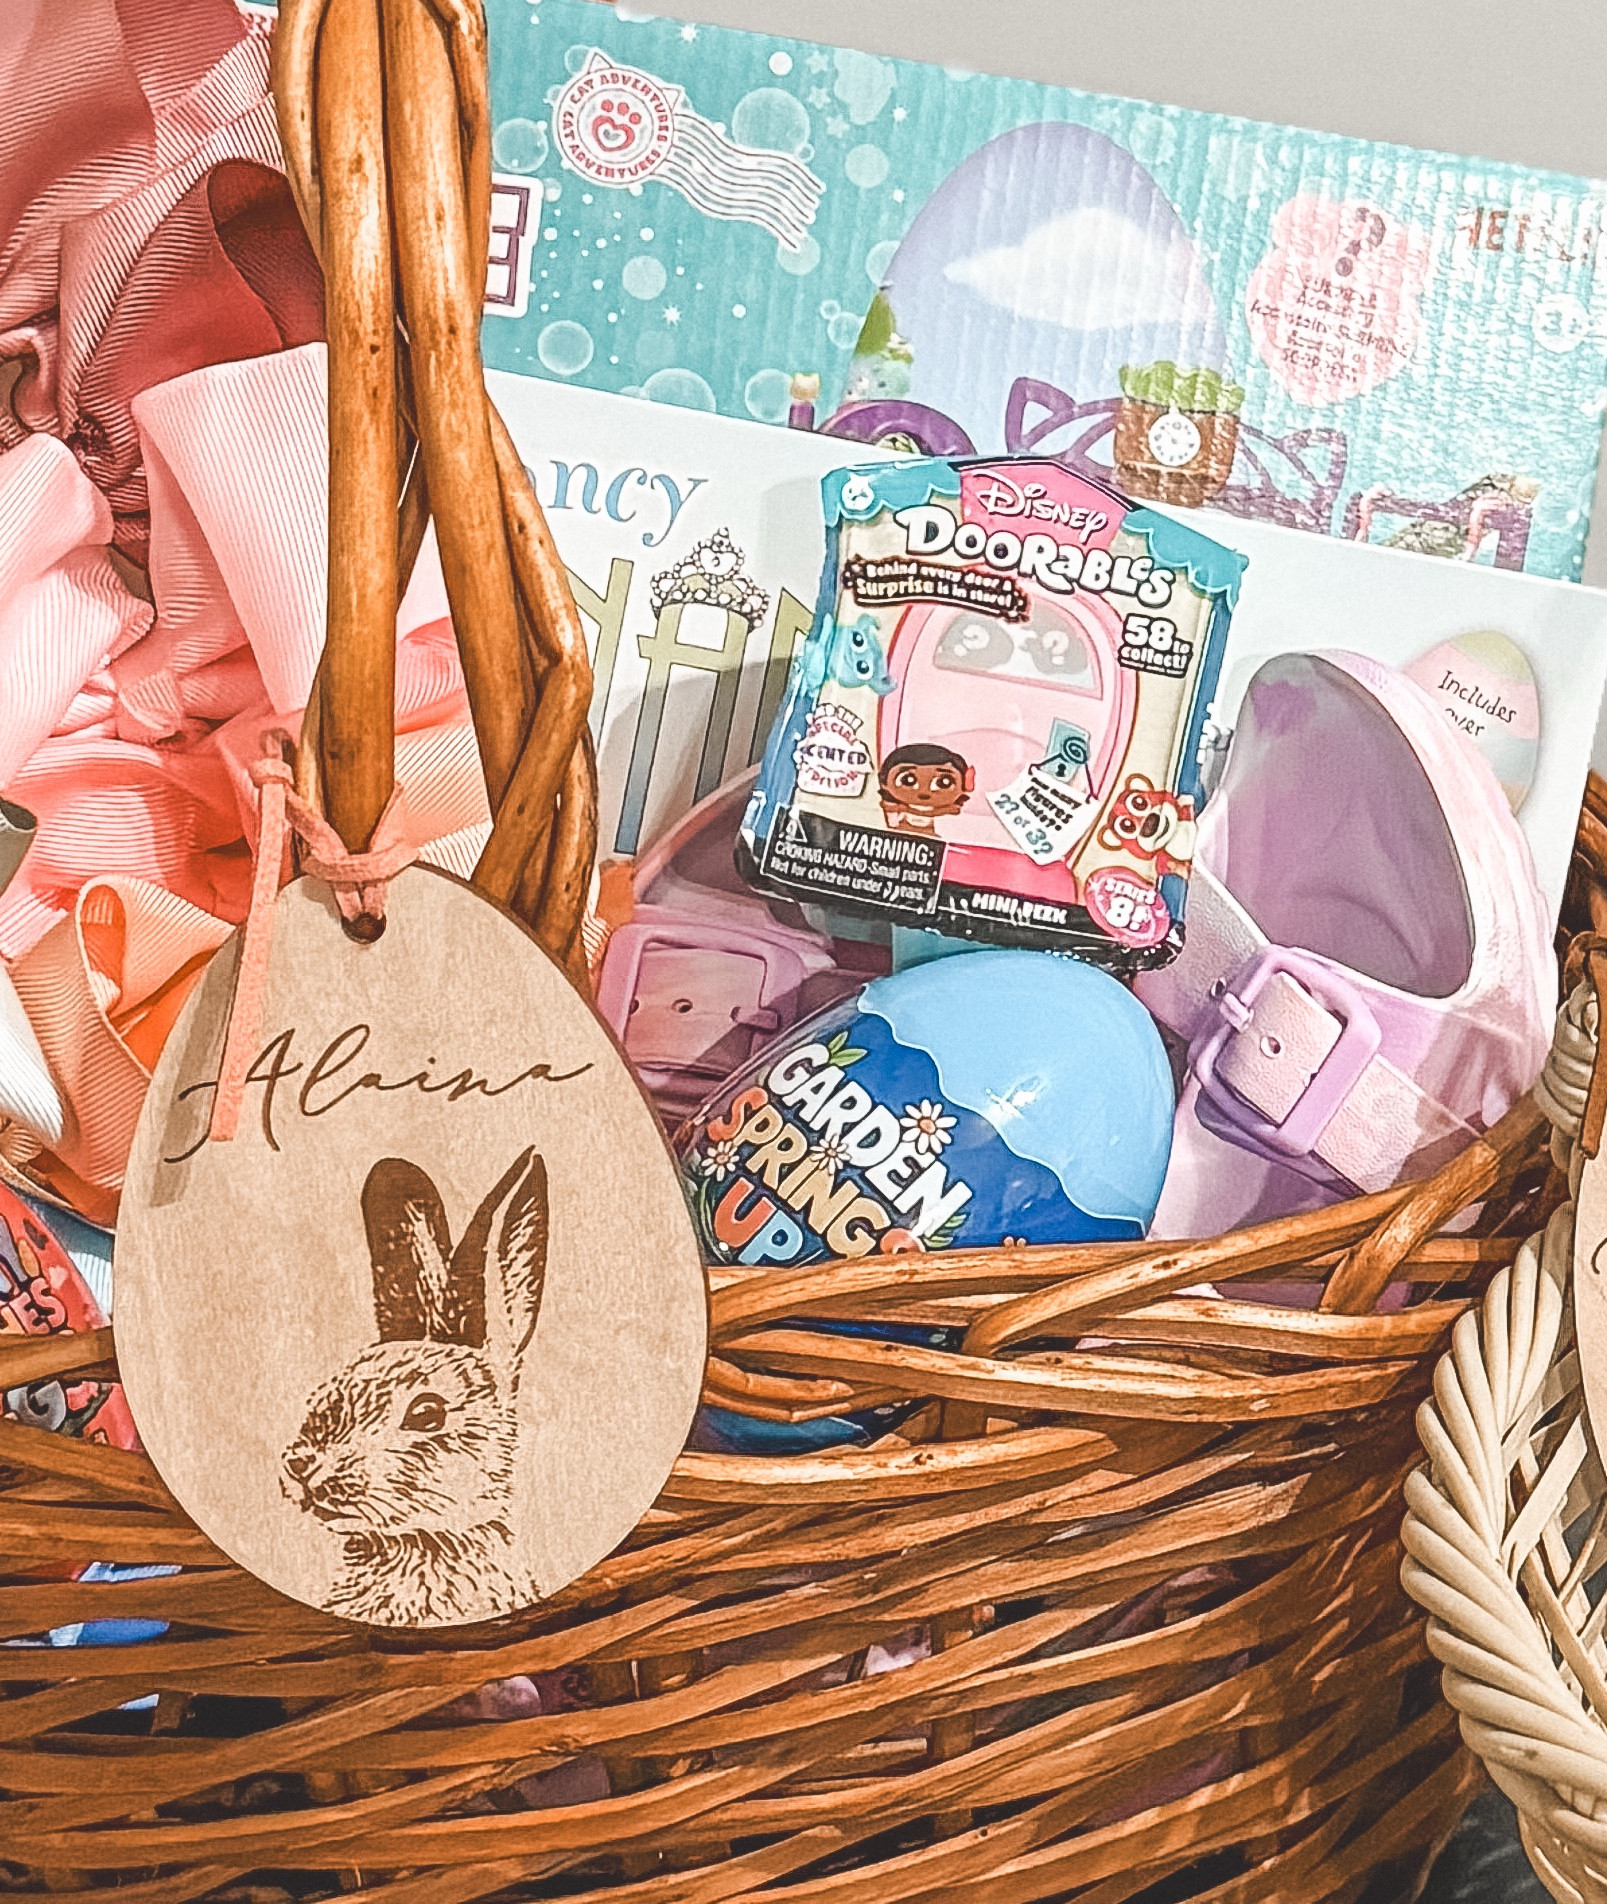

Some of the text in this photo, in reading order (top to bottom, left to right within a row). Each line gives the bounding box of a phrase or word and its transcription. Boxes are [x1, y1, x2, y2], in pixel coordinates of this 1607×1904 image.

[524, 460, 709, 547] ncy
[856, 576, 934, 597] Surprise
[866, 561, 917, 578] Behind
[920, 566, 962, 583] every
[1124, 616, 1175, 652] 58
[1120, 646, 1188, 670] collect!
[1437, 670, 1517, 724] Includes
[805, 767, 858, 788] DITION
[839, 829, 935, 867] WARNING:
[163, 1023, 595, 1164] Alaina
[767, 1040, 973, 1238] GARDEN
[713, 1176, 804, 1265] UP
